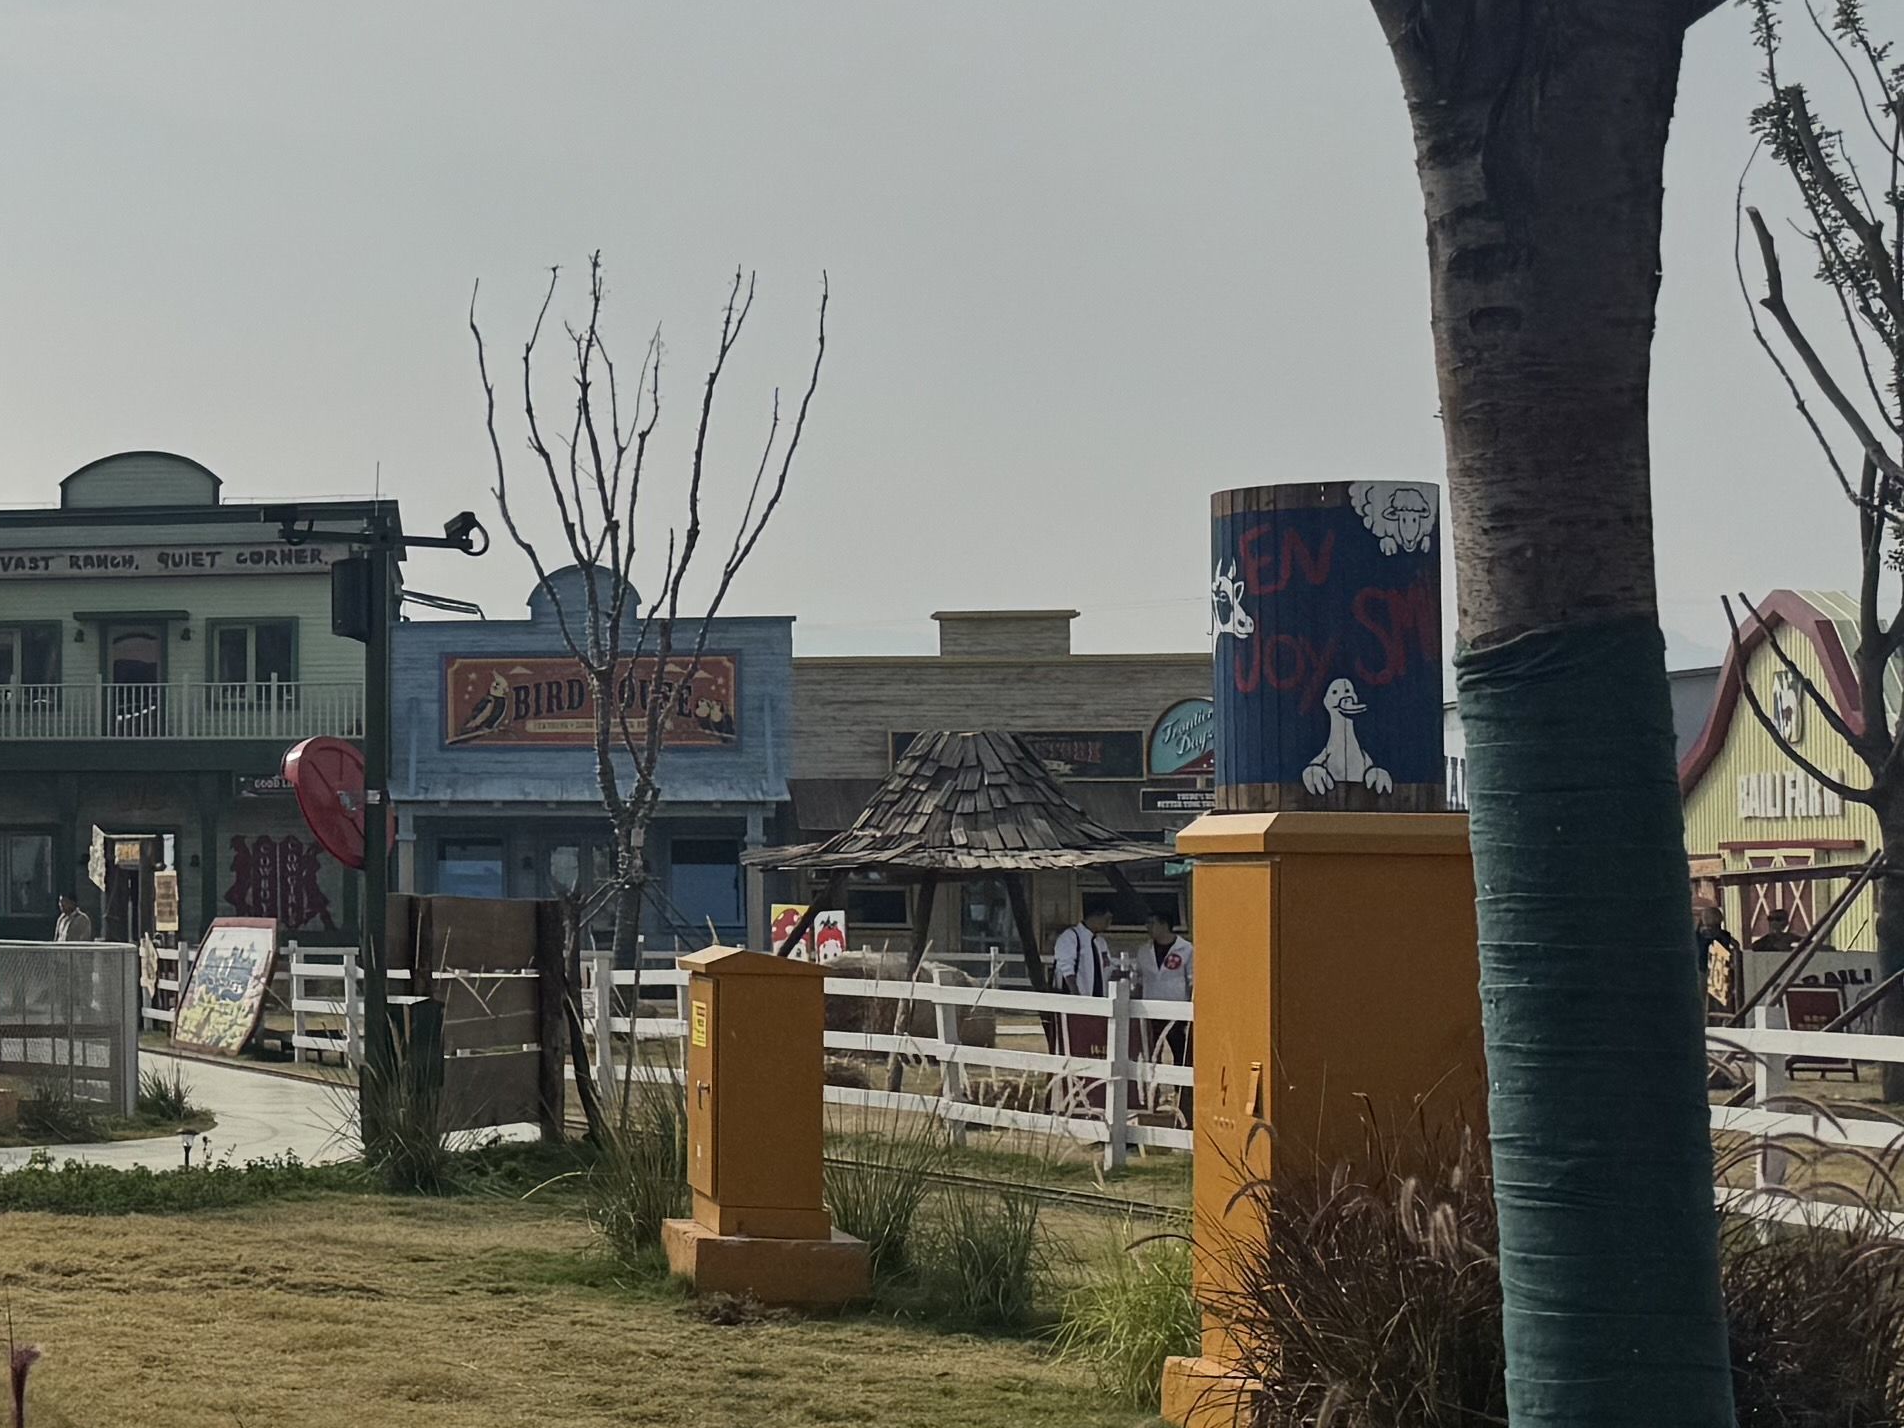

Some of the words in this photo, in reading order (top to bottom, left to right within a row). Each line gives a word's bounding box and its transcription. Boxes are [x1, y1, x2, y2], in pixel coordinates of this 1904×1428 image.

[0, 556, 54, 572] VAST
[158, 551, 222, 568] QUIET
[513, 678, 586, 721] BIRD
[599, 677, 693, 718] OUE
